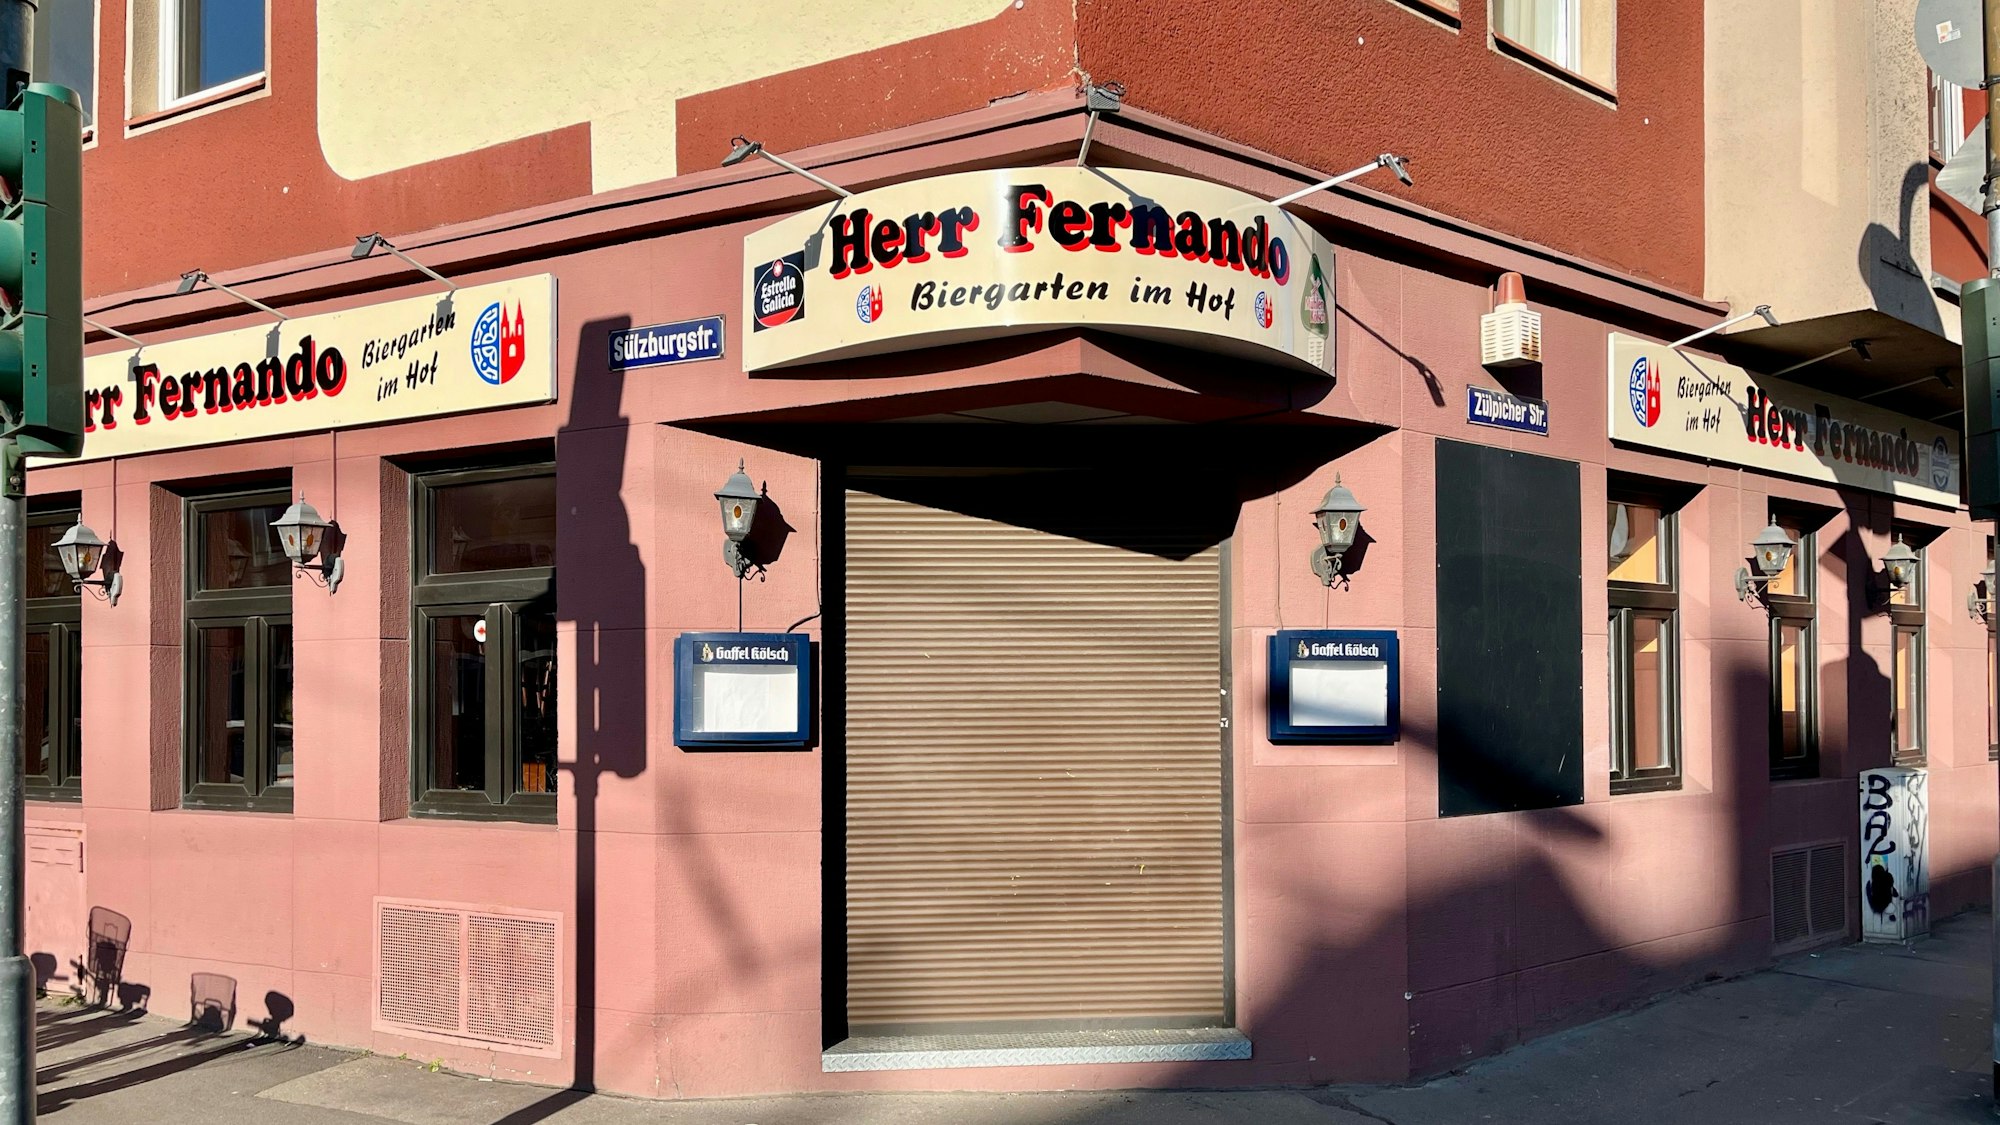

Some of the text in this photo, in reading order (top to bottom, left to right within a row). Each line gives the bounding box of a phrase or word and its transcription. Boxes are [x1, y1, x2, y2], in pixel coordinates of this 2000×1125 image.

[829, 184, 1290, 286] Herr Fernando
[760, 275, 797, 300] Estrella
[761, 290, 795, 315] Galicia
[910, 272, 1236, 321] Biergarten im Hof
[362, 311, 456, 369] Biergarten
[613, 324, 718, 362] Sülzburgstr.
[83, 334, 348, 433] rr Fernando
[376, 350, 438, 402] im Hof
[1676, 374, 1732, 403] Biergarten
[1473, 391, 1547, 428] Zülpicher Str.
[1685, 406, 1722, 433] im Hof
[1745, 384, 1920, 477] Herr Fernando
[715, 646, 789, 662] Gaffel Kölsch
[1311, 642, 1380, 658] Gaffel Kölsch
